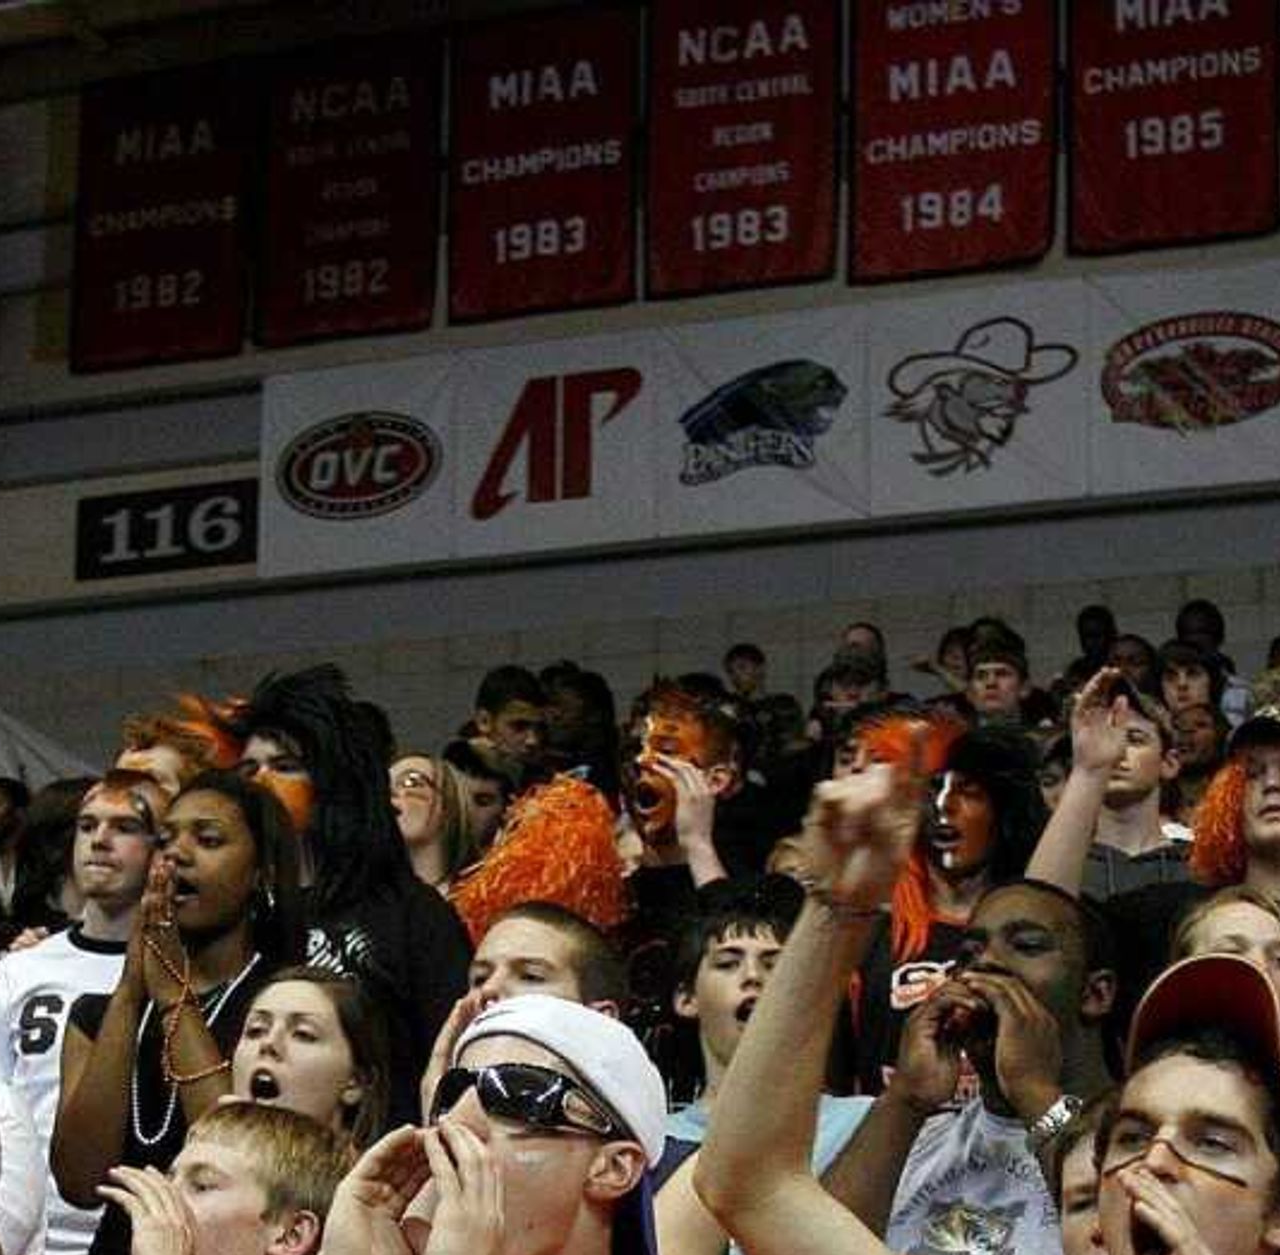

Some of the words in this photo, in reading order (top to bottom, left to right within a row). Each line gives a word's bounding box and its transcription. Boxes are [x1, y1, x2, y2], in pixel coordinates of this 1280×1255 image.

[676, 14, 810, 67] NCAA
[487, 58, 600, 110] MIAA
[888, 49, 1017, 103] MIAA
[1083, 46, 1262, 95] CHAMPIONS
[288, 77, 410, 124] NCAA
[865, 118, 1044, 165] CHAMPIONS
[1125, 109, 1226, 161] 1985
[460, 139, 622, 187] CHAMPIONS
[690, 204, 792, 254] 1983
[902, 182, 1005, 234] 1984
[494, 215, 587, 266] 1983
[117, 267, 204, 309] 1982
[302, 255, 392, 304] 1982
[309, 443, 407, 491] OVC
[99, 497, 242, 565] 116
